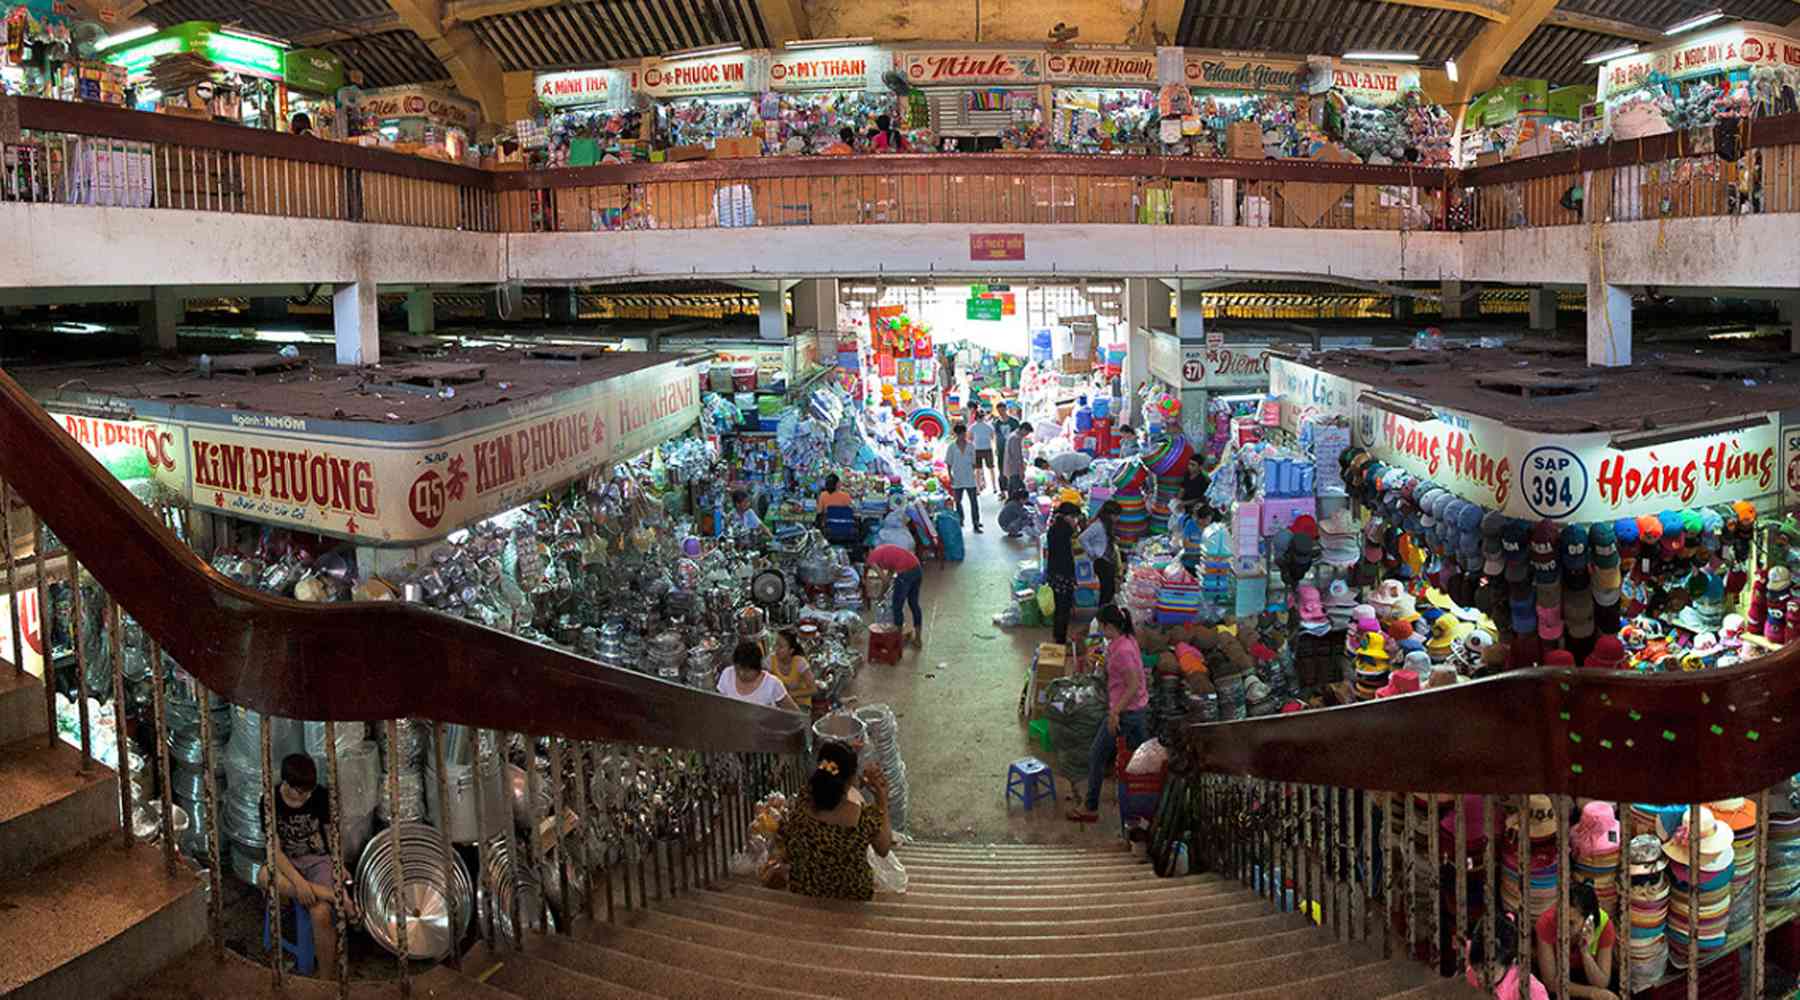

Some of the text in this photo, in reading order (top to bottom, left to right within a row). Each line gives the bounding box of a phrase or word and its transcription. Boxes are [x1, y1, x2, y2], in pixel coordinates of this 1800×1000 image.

[928, 55, 1014, 78] Minh
[1068, 56, 1100, 74] Kim
[1202, 61, 1251, 82] Thanh
[1184, 362, 1202, 379] 371
[1447, 431, 1512, 504] Hùng
[1596, 452, 1697, 506] Hoàng
[1703, 440, 1774, 488] Hùng
[415, 478, 444, 519] 45
[1532, 475, 1573, 507] 394
